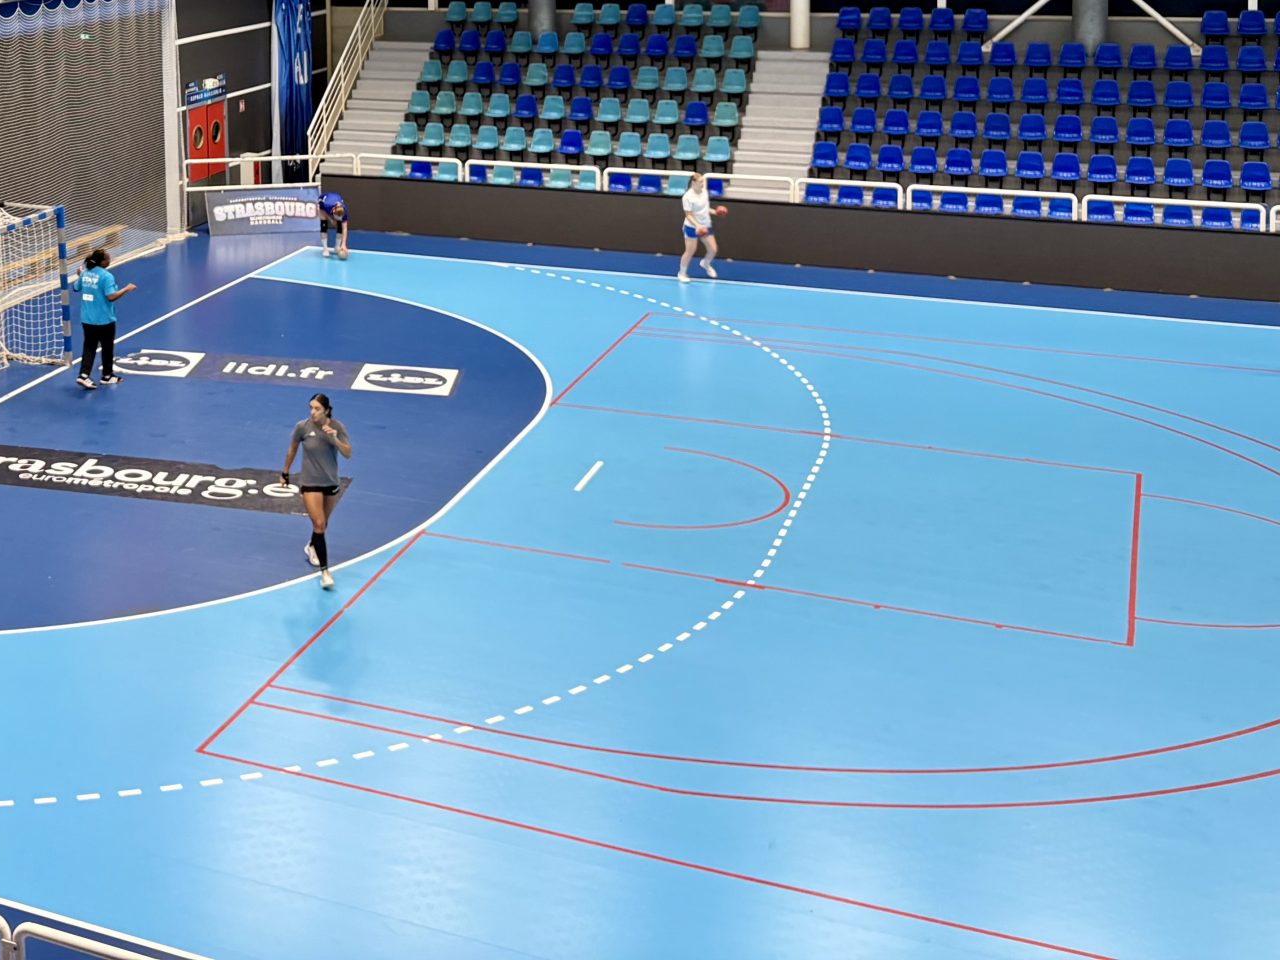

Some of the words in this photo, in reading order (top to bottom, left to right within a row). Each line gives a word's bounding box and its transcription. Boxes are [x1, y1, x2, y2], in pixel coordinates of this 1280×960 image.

[213, 201, 318, 222] STRASBOURG
[222, 360, 335, 382] lidl.fr
[18, 470, 192, 496] eurométropole
